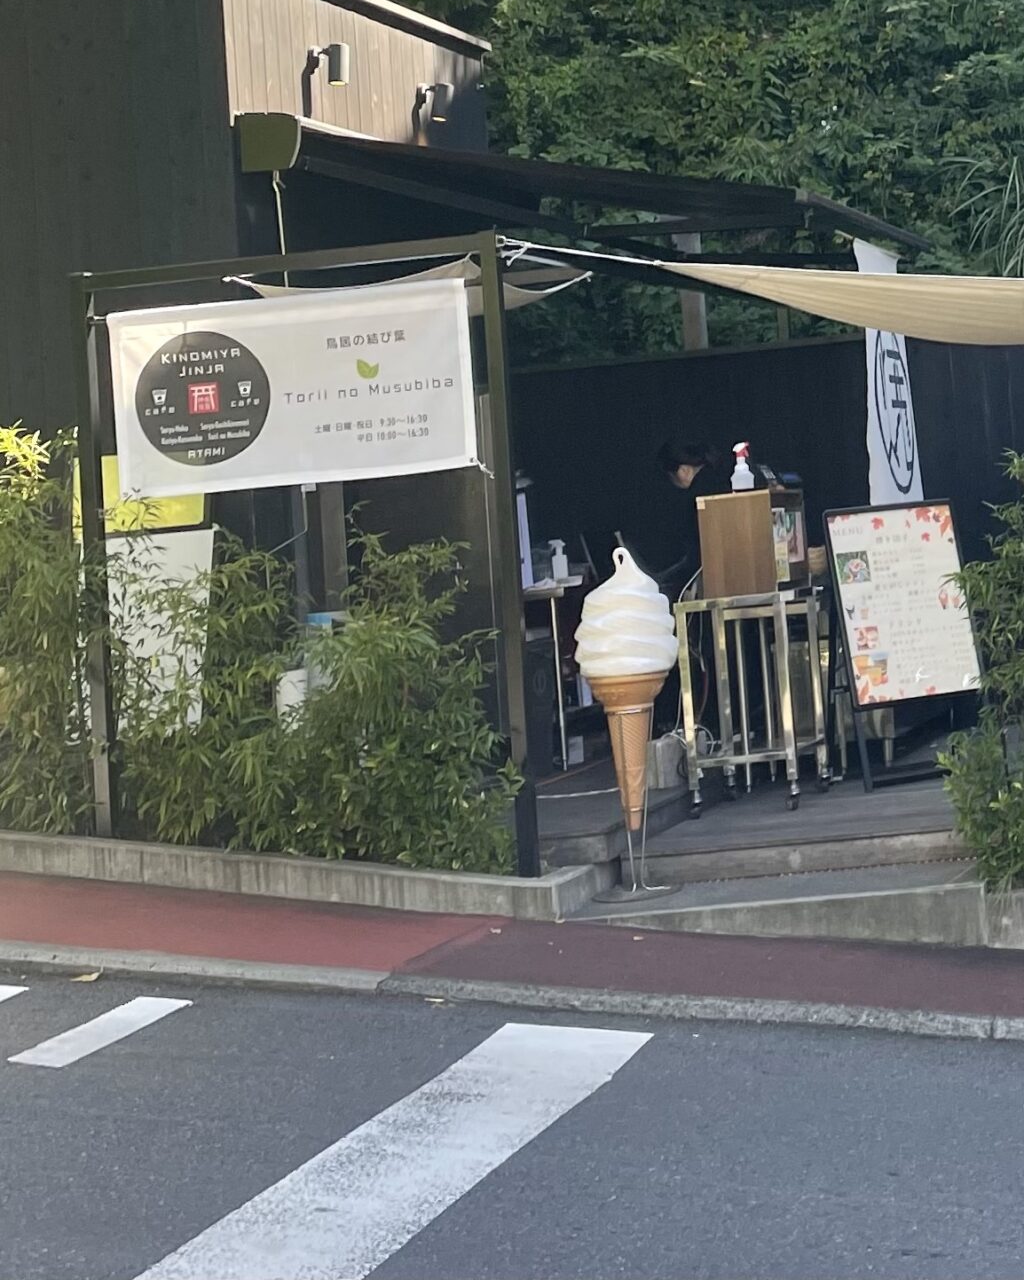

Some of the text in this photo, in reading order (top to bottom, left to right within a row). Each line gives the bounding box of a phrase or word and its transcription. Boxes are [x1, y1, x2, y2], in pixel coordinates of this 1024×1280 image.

[161, 347, 240, 364] KINOMIYA
[179, 363, 224, 377] JINJA
[284, 377, 454, 404] Torii no Musubiba
[188, 447, 225, 459] ATAMI
[832, 526, 864, 537] MENU
